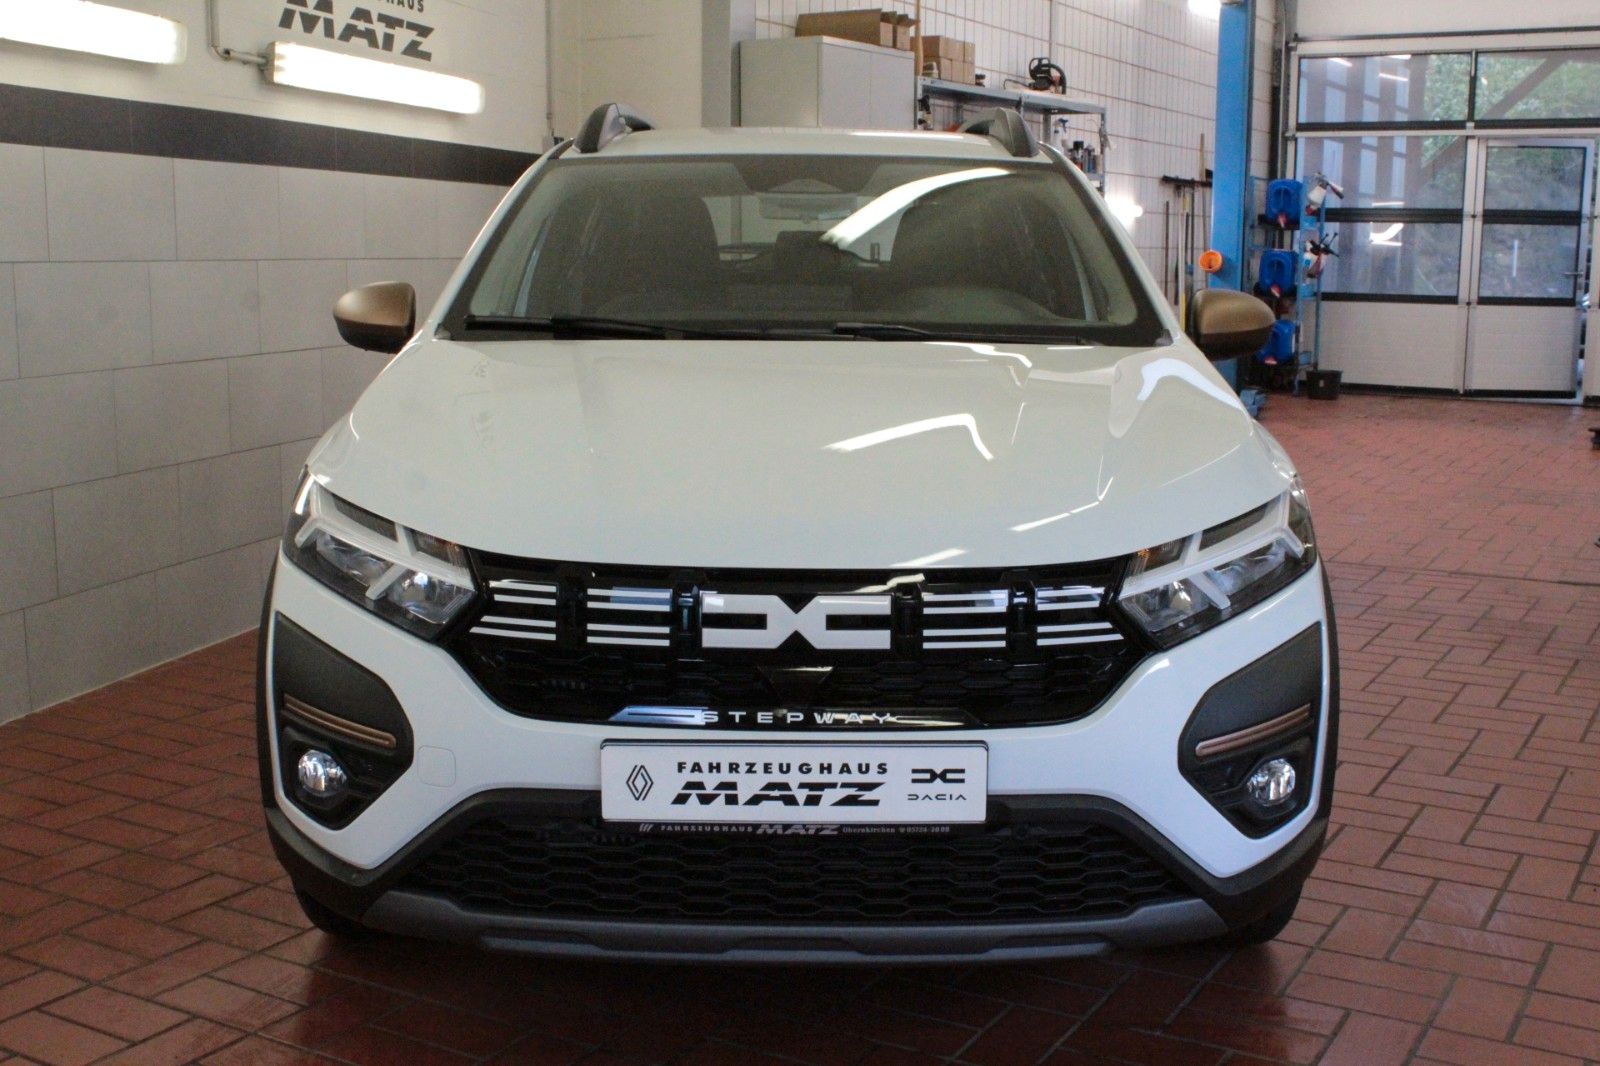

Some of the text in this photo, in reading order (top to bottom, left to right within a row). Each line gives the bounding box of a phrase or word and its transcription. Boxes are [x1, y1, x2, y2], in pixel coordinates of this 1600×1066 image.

[278, 0, 435, 62] MATZ
[703, 711, 890, 725] STEPWAY
[677, 762, 888, 775] FAHRZEUGHAUS
[670, 781, 886, 806] MATZ
[907, 793, 967, 801] DACIA
[660, 825, 753, 833] FAHRZEUGHAUS
[755, 824, 841, 835] MATZ
